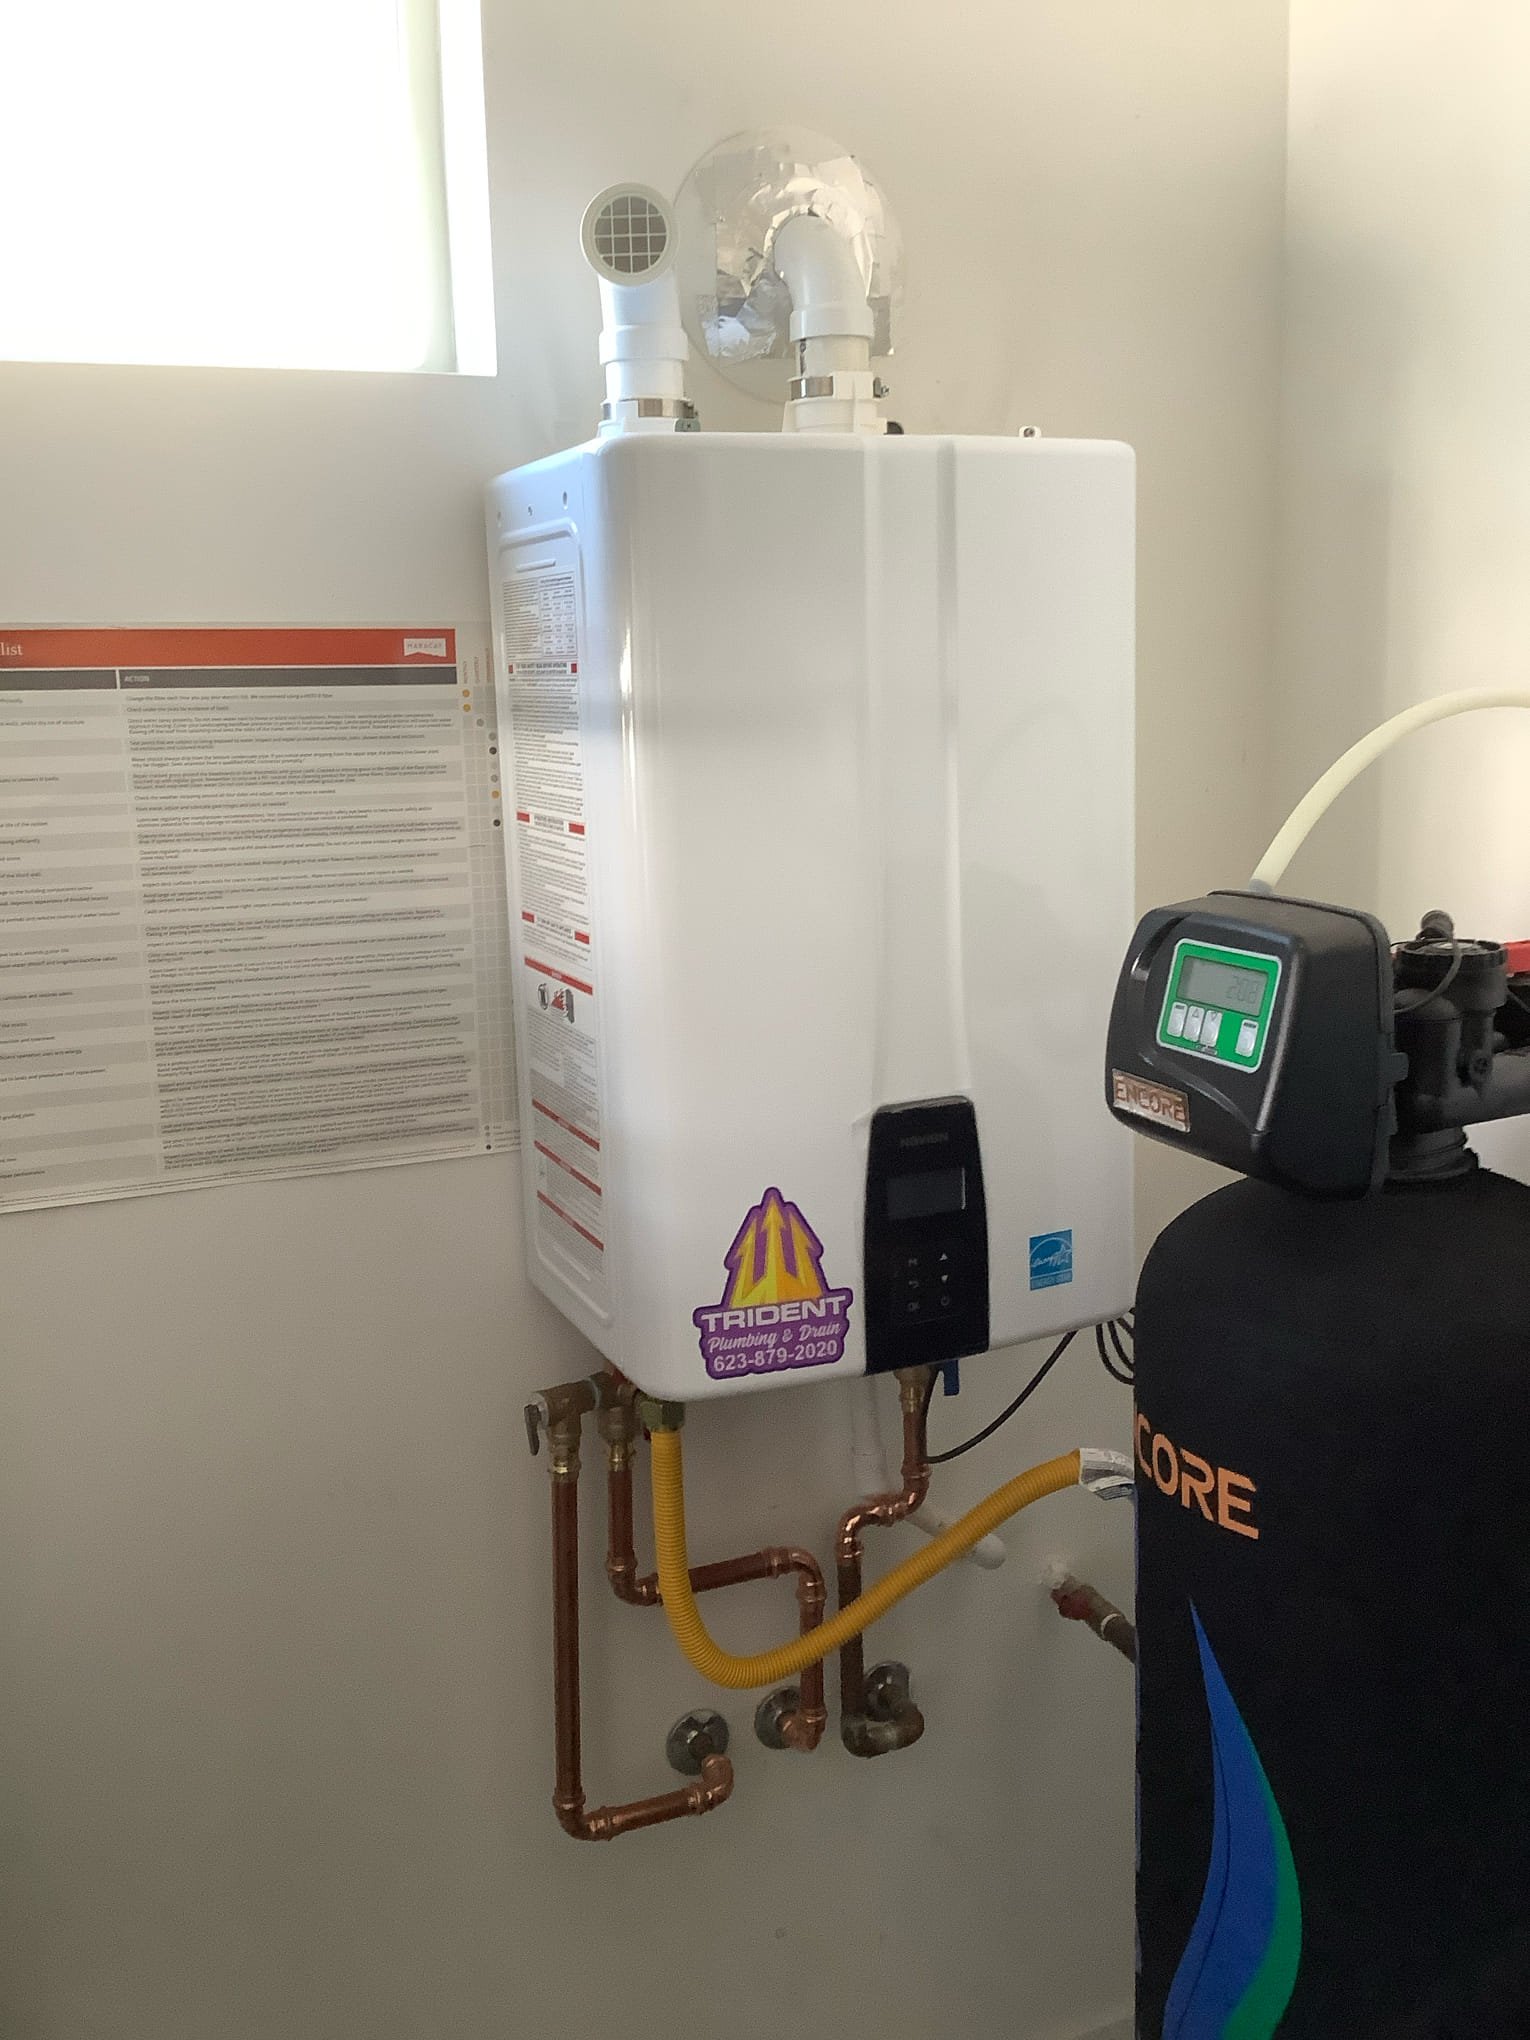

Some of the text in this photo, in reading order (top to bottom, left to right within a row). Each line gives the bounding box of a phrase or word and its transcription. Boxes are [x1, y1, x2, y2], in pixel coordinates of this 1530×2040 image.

[0, 642, 23, 656] list
[124, 675, 150, 683] ACTION
[1115, 1079, 1186, 1122] ENCORE
[701, 1296, 846, 1333] TRIDENT
[708, 1322, 841, 1354] Plumbing & Drain
[713, 1340, 838, 1372] 623-879-2020
[1136, 1413, 1259, 1540] CORE
